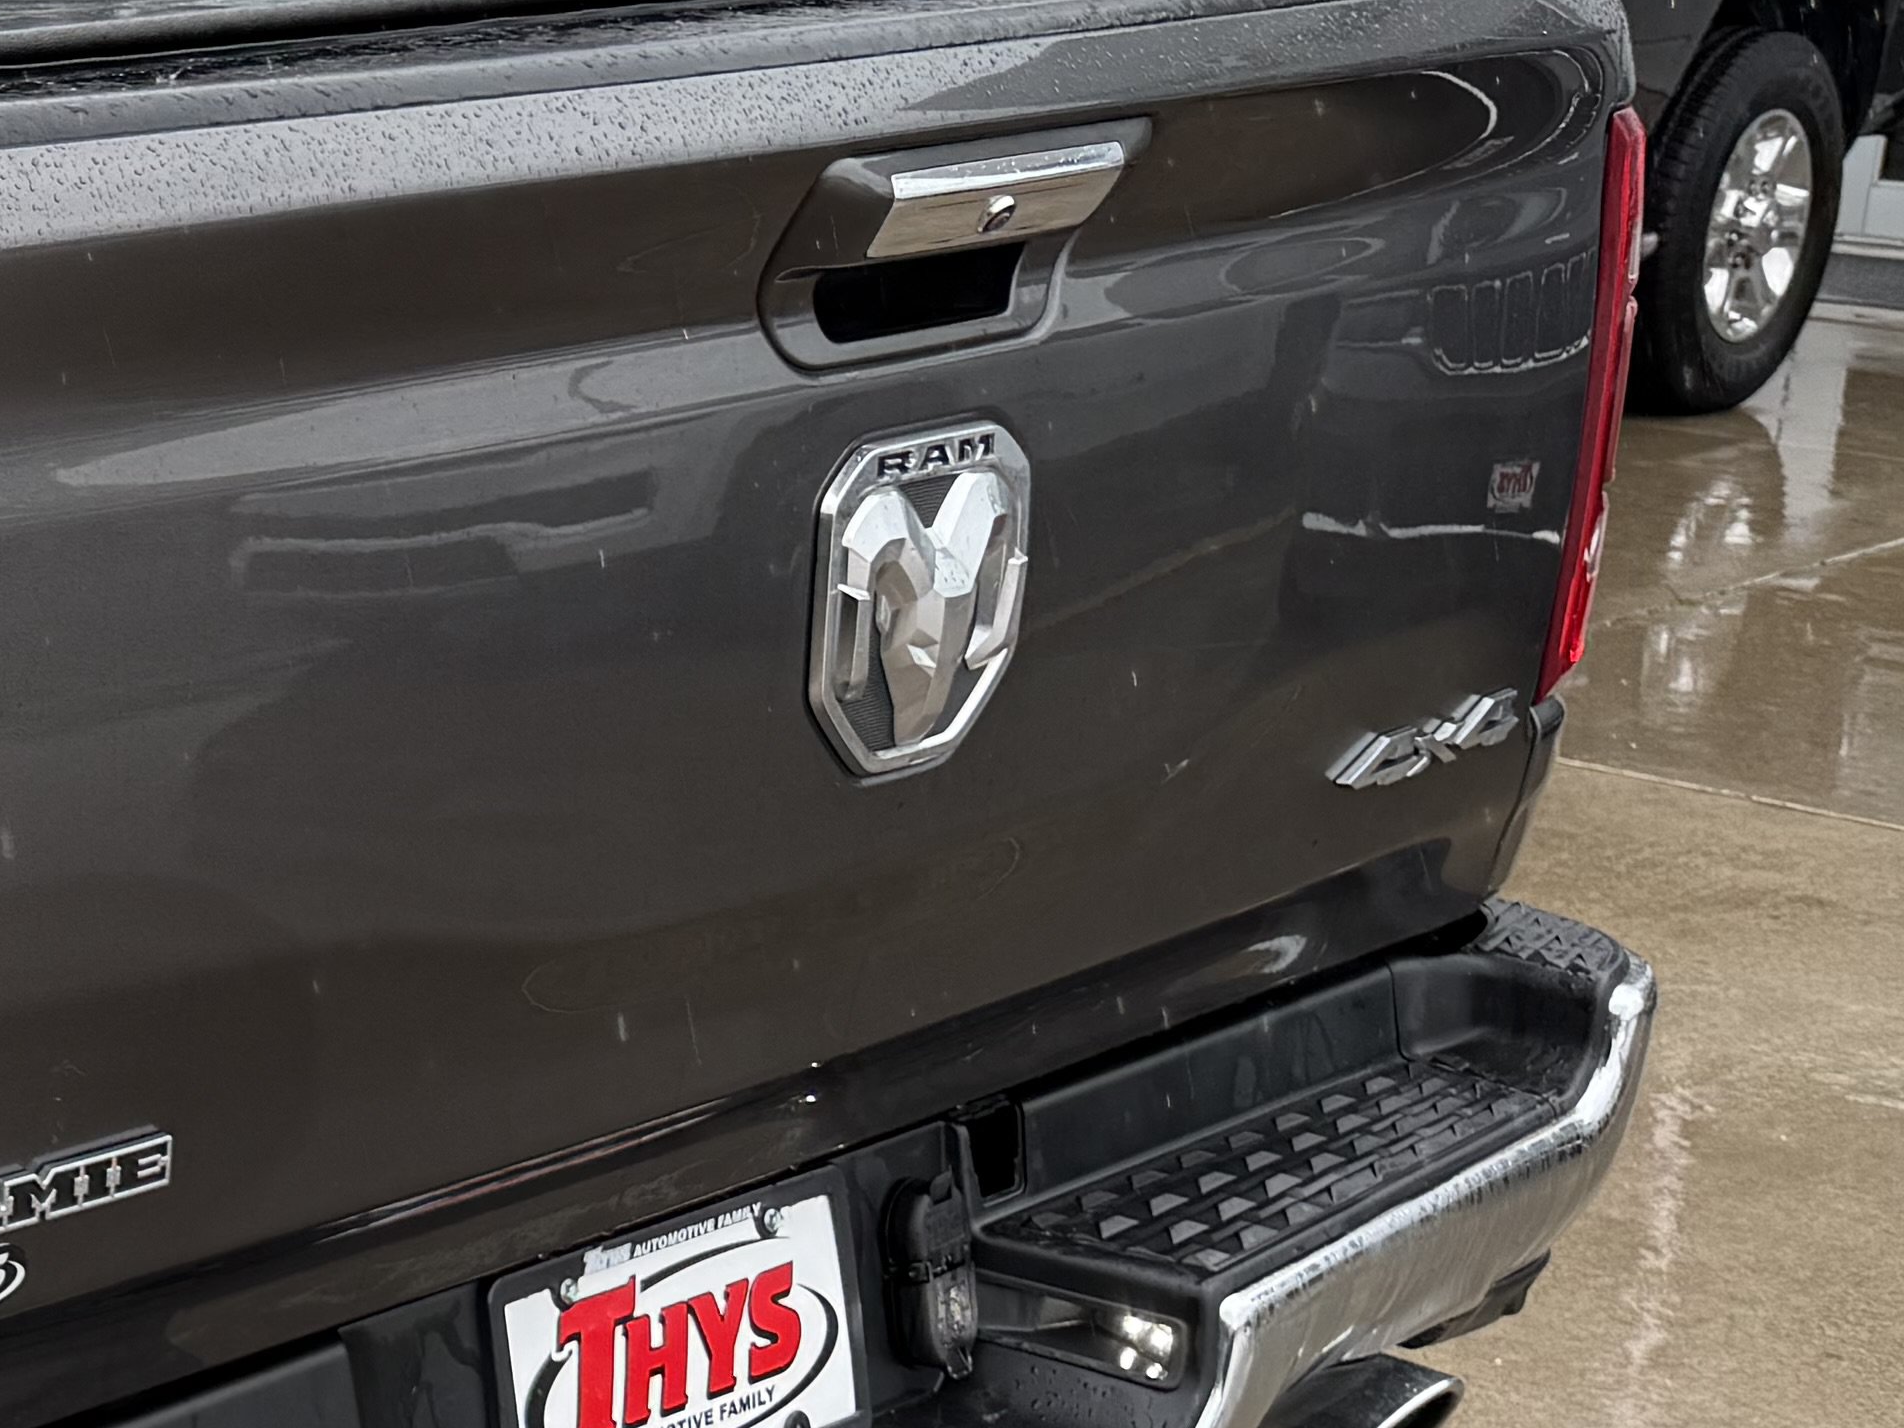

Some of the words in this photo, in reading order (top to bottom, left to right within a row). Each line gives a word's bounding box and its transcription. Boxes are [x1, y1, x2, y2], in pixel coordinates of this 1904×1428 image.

[877, 432, 995, 477] RAM
[633, 1220, 715, 1258] AUTOMOTIVE
[718, 1202, 762, 1229] FAMILY
[719, 1385, 775, 1422] FAMILY
